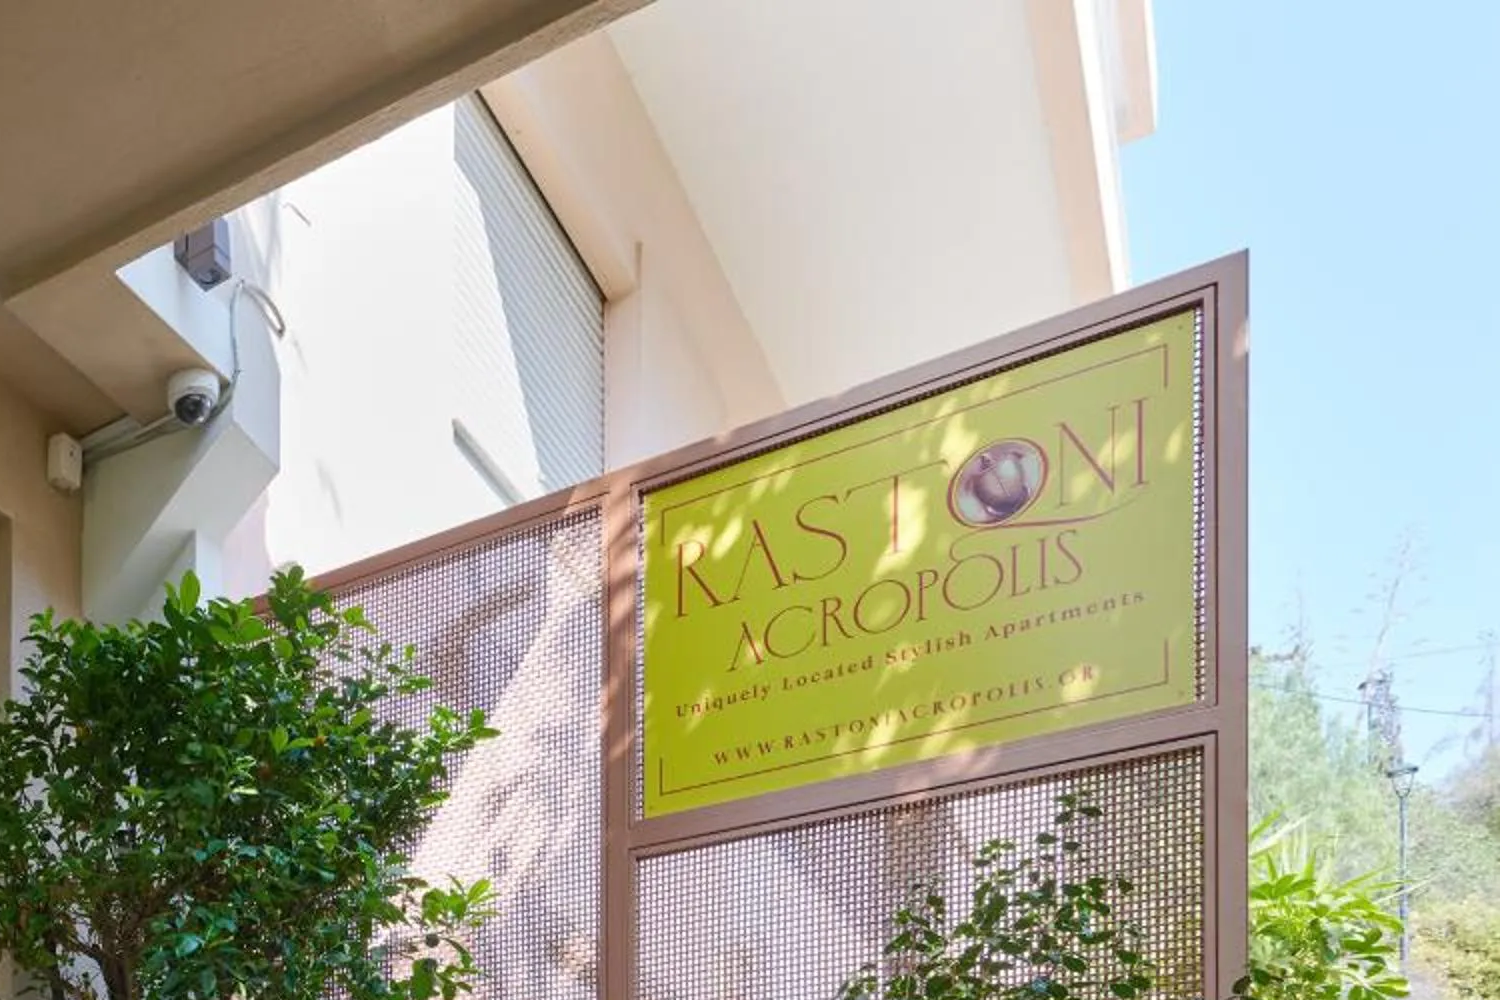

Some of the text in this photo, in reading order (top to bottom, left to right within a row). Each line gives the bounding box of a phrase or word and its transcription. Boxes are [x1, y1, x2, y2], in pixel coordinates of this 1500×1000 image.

[675, 396, 1149, 618] RASTONI
[676, 591, 1145, 718] Uniquely Located Stylish Apartments
[727, 529, 1083, 672] ACROPOLIS
[713, 665, 1094, 767] WWWRASTONIACROPOLIS.GR
